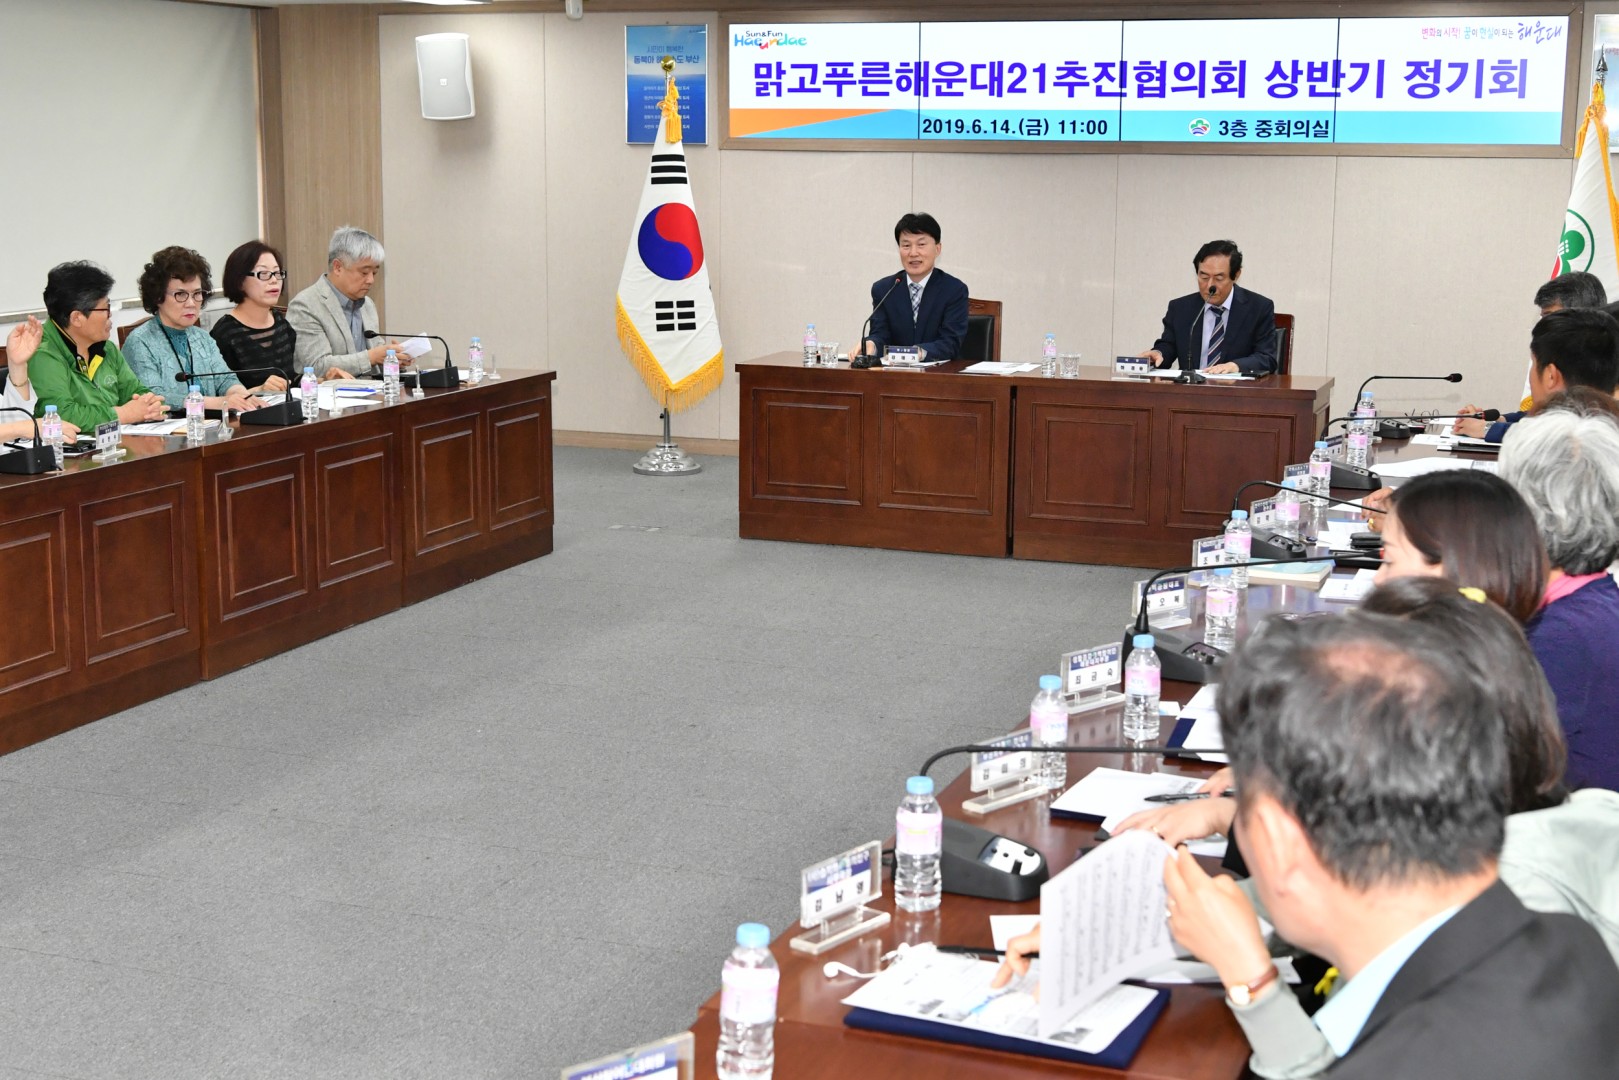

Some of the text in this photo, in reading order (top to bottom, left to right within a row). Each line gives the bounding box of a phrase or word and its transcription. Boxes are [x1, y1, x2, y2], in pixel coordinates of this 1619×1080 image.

[745, 30, 783, 38] Sun&Fun
[1422, 20, 1562, 45] 변화의 시작! 꿈이 현실이 되는 해운대
[634, 55, 655, 64] 동북아
[685, 55, 700, 64] 부산
[754, 58, 1528, 99] 맑고푸른해운대21추진협의회 상반기 정기회
[922, 119, 1108, 136] 2019.6.14.(금) 11:00
[1218, 119, 1330, 138] 3층 중회의실
